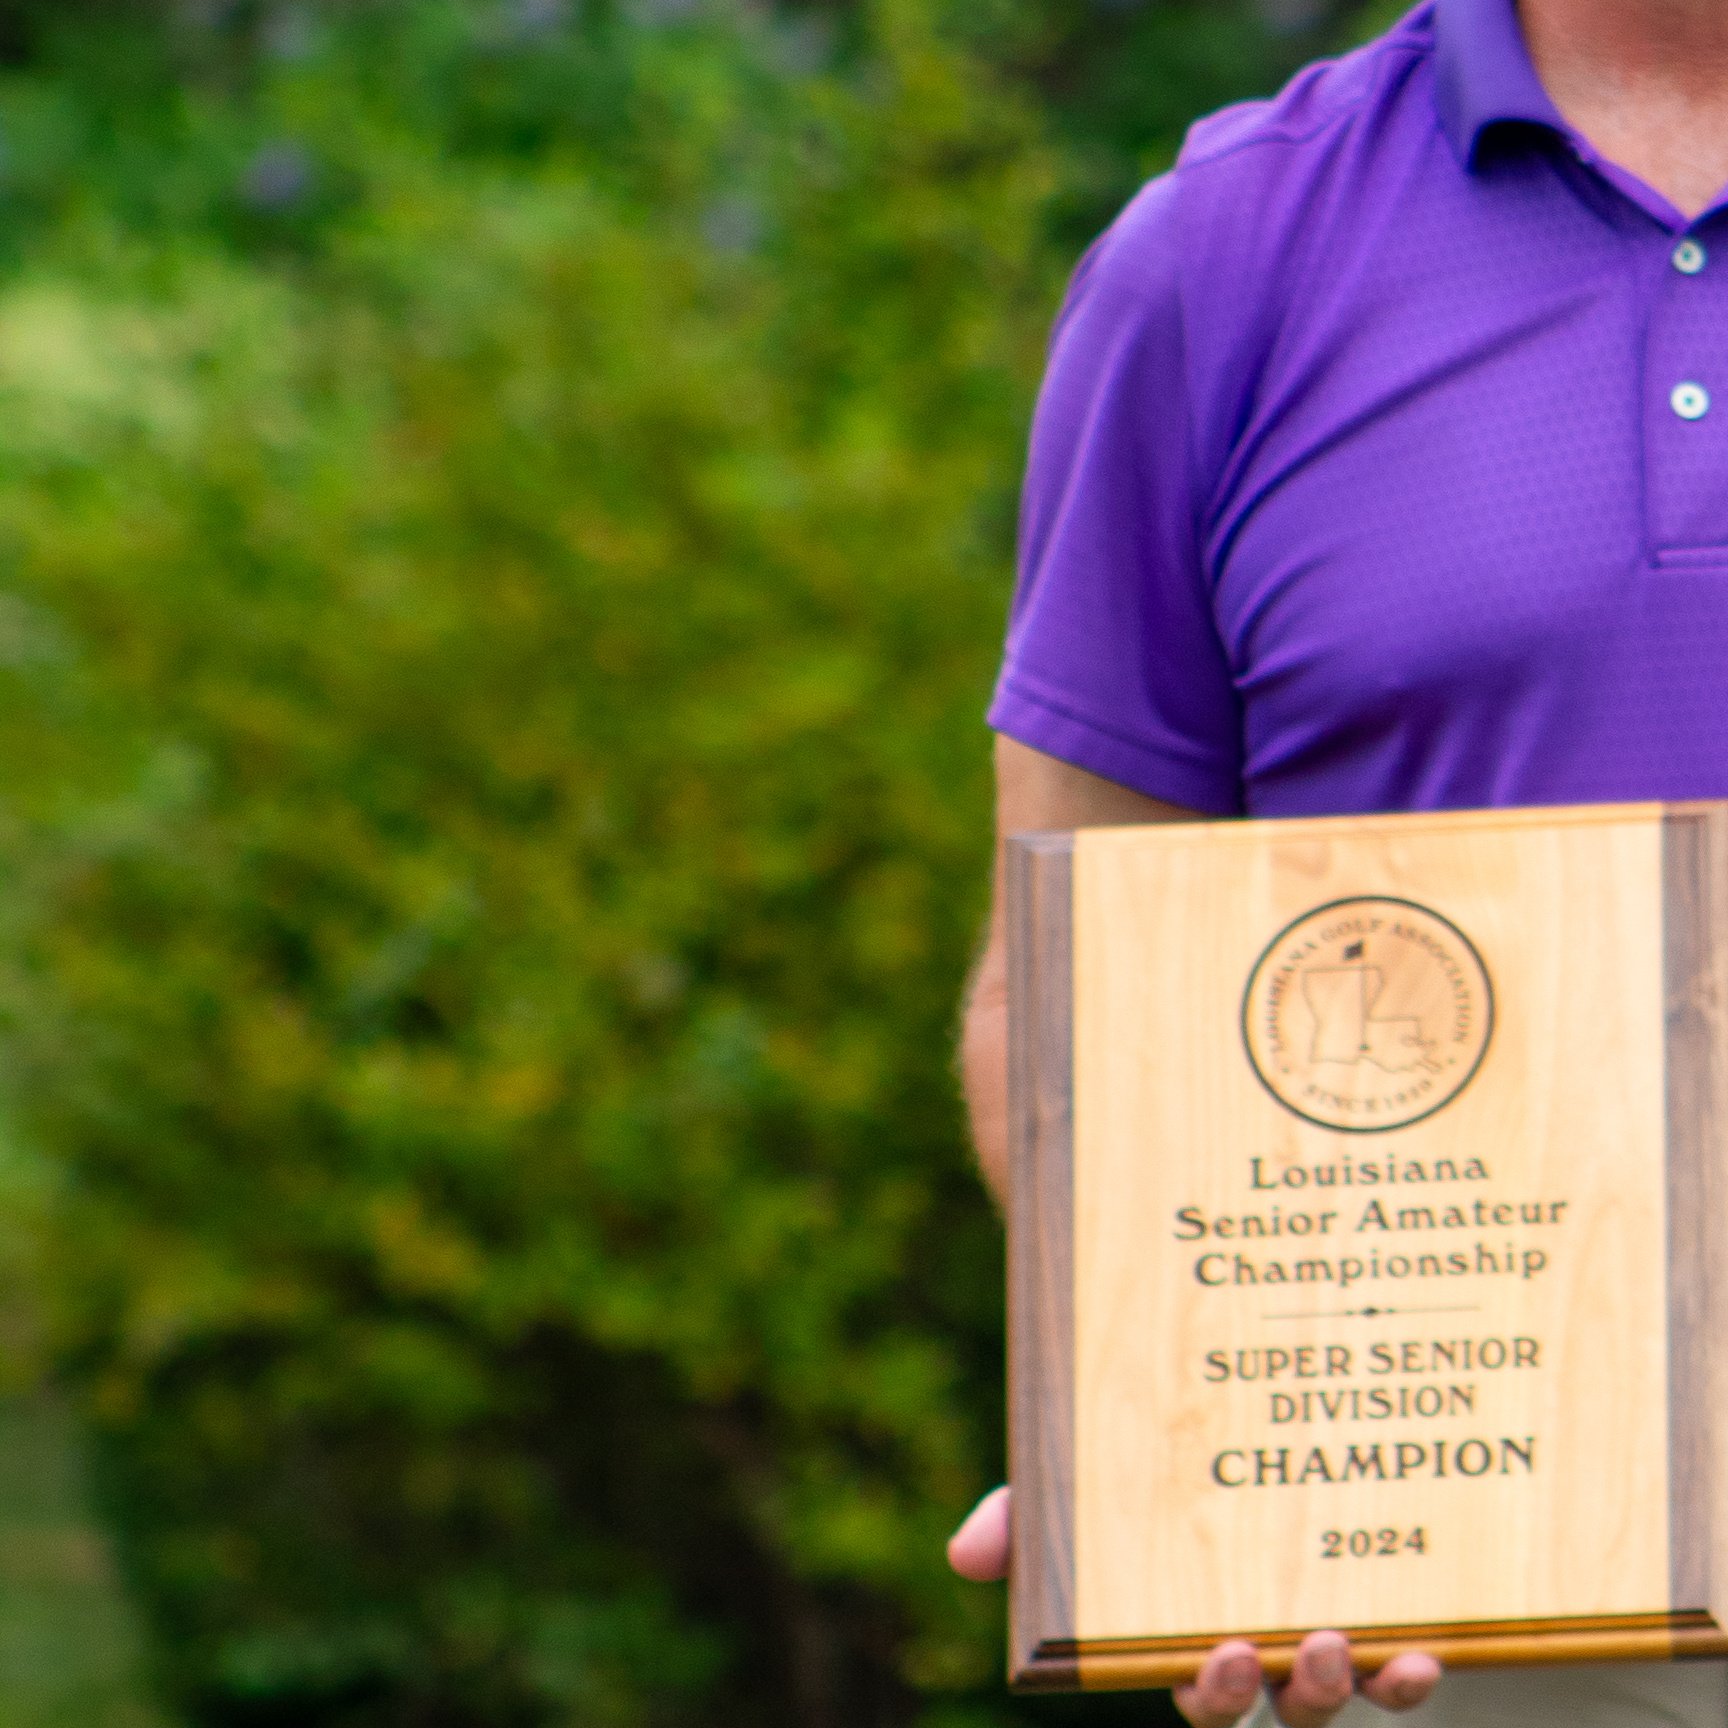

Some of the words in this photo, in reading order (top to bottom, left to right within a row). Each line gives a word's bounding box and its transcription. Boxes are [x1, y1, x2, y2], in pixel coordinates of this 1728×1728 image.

[1250, 1154, 1489, 1190] Louisiana
[1174, 1206, 1338, 1240] Senior
[1356, 1199, 1568, 1232] Amateur
[1193, 1242, 1548, 1288] Championship
[1205, 1346, 1352, 1382] SUPER
[1369, 1338, 1540, 1374] SENIOR
[1270, 1385, 1475, 1424] DIVISION
[1211, 1437, 1535, 1488] CHAMPION
[1321, 1527, 1427, 1559] 2024
